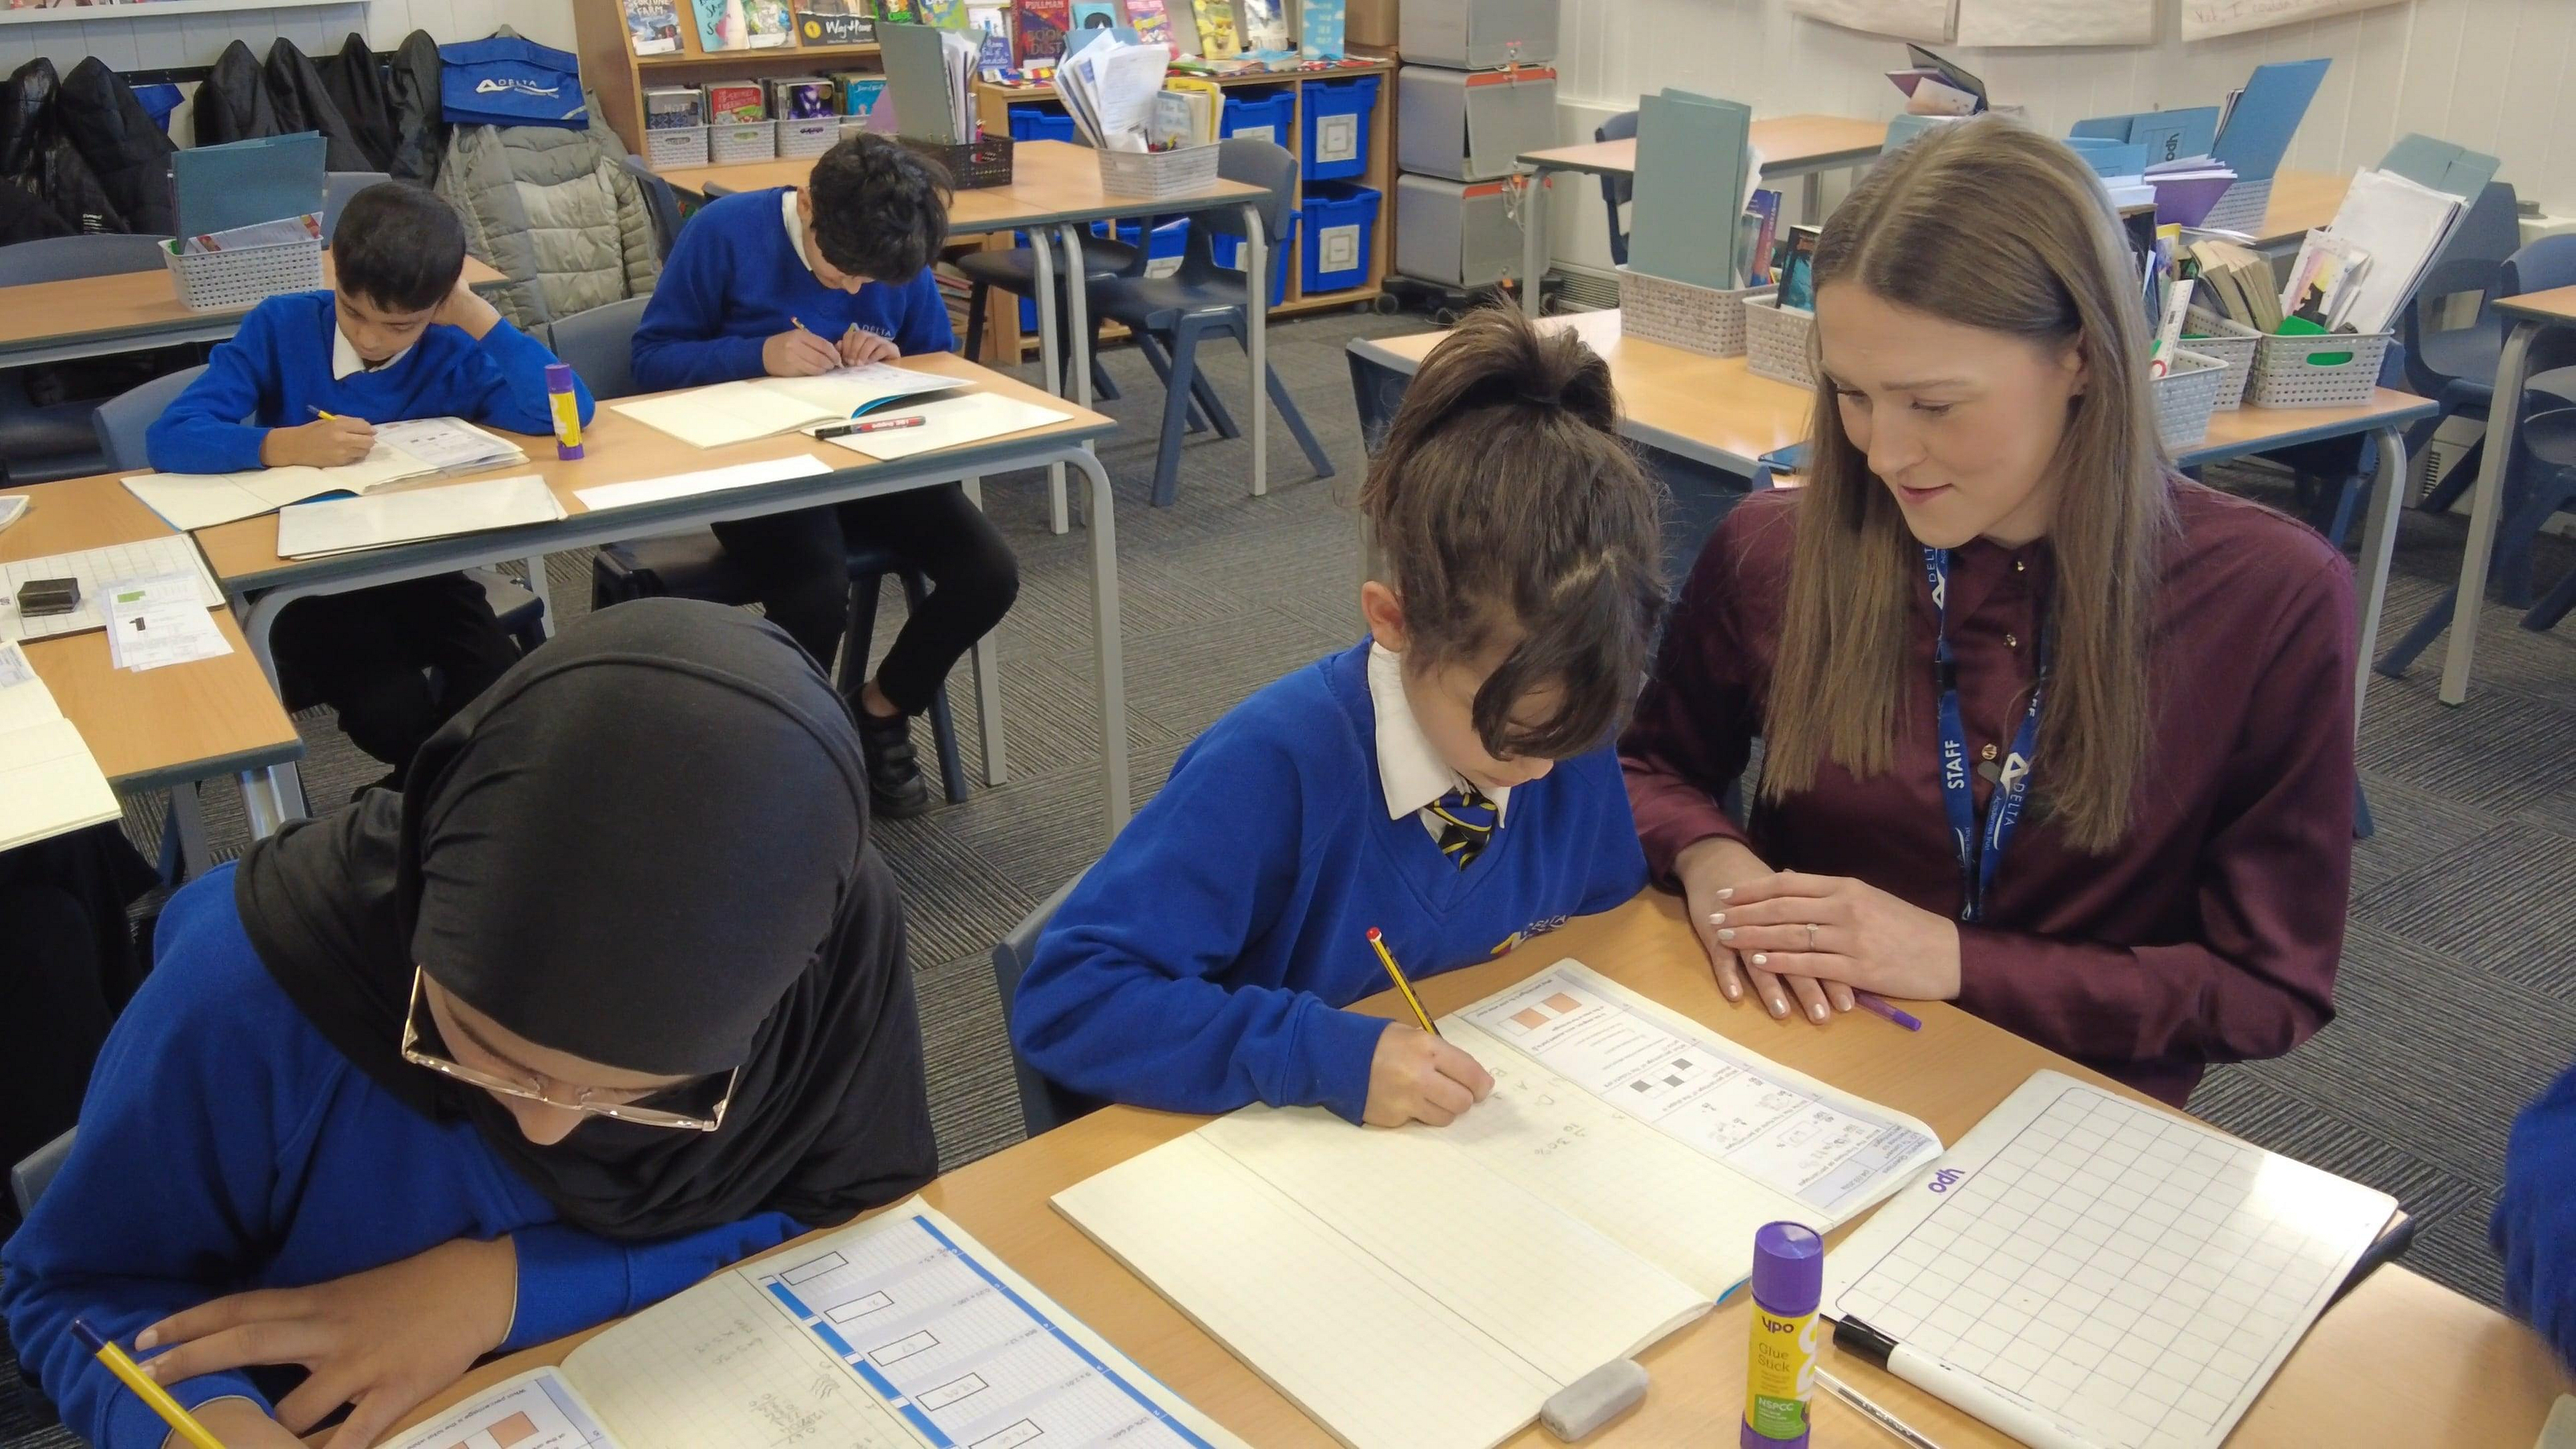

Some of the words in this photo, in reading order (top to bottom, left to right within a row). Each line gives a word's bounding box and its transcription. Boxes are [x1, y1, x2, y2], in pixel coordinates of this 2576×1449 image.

[1026, 1, 1063, 9] PULLMAN
[498, 79, 537, 87] DELTA
[1924, 547, 1937, 582] DELT
[1945, 739, 1965, 790] STAFF
[2002, 781, 2025, 828] DELTA
[1986, 795, 2001, 835] Academies
[1984, 836, 1992, 851] Trust
[1928, 1166, 1966, 1195] ypo
[1762, 1315, 1794, 1333] ypo
[1758, 1342, 1789, 1360] Glue
[1757, 1354, 1790, 1373] Stick
[462, 1394, 506, 1421] percentage
[1151, 1409, 1160, 1417] 2
[1758, 1397, 1794, 1412] NSPCC
